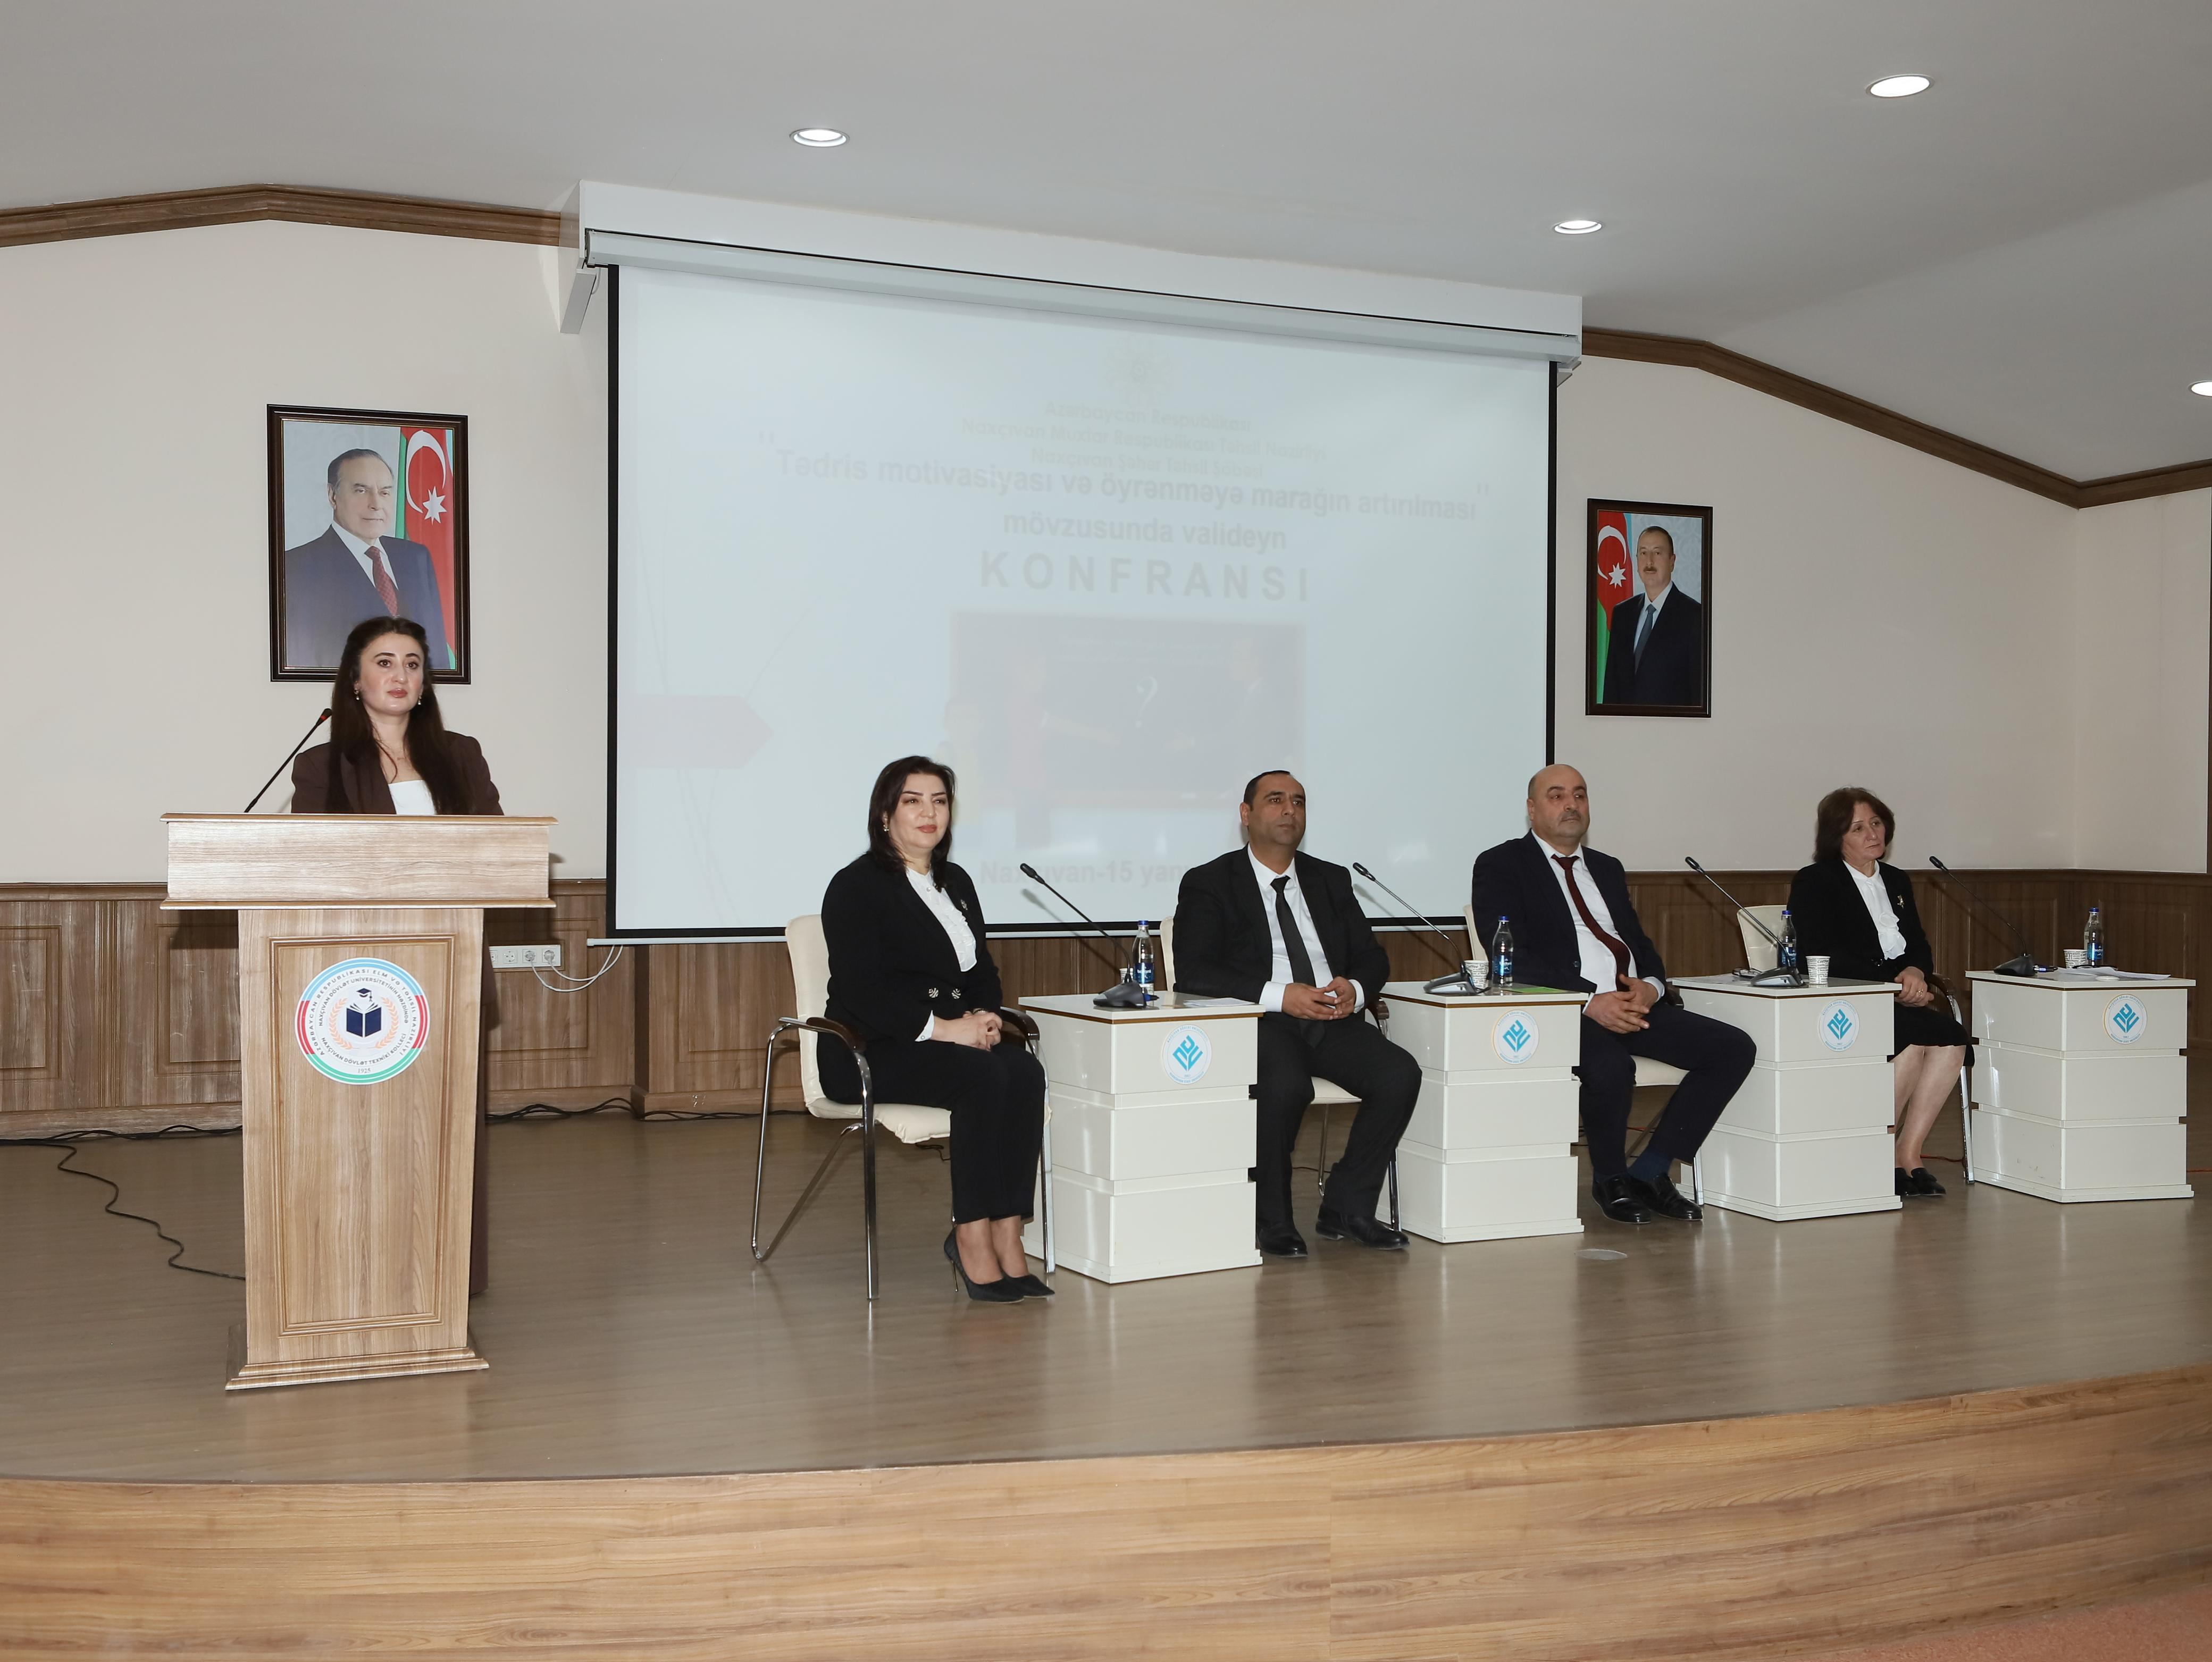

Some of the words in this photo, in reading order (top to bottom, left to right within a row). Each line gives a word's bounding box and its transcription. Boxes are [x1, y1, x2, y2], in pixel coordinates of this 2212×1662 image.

[878, 459, 1052, 496] motivasiyası
[1061, 474, 1092, 494] və
[1100, 472, 1243, 510] öyrənməyə
[1252, 486, 1350, 517] marağın
[1004, 511, 1173, 542] mövzusunda
[1183, 521, 1287, 555] valideyn
[981, 550, 1308, 603] KONFRANSI
[1140, 864, 1190, 888] yan
[319, 997, 330, 1026] NAXÇIVAN
[329, 980, 350, 997] DÖVLƏT
[321, 1037, 344, 1060] NAXÇIVAN
